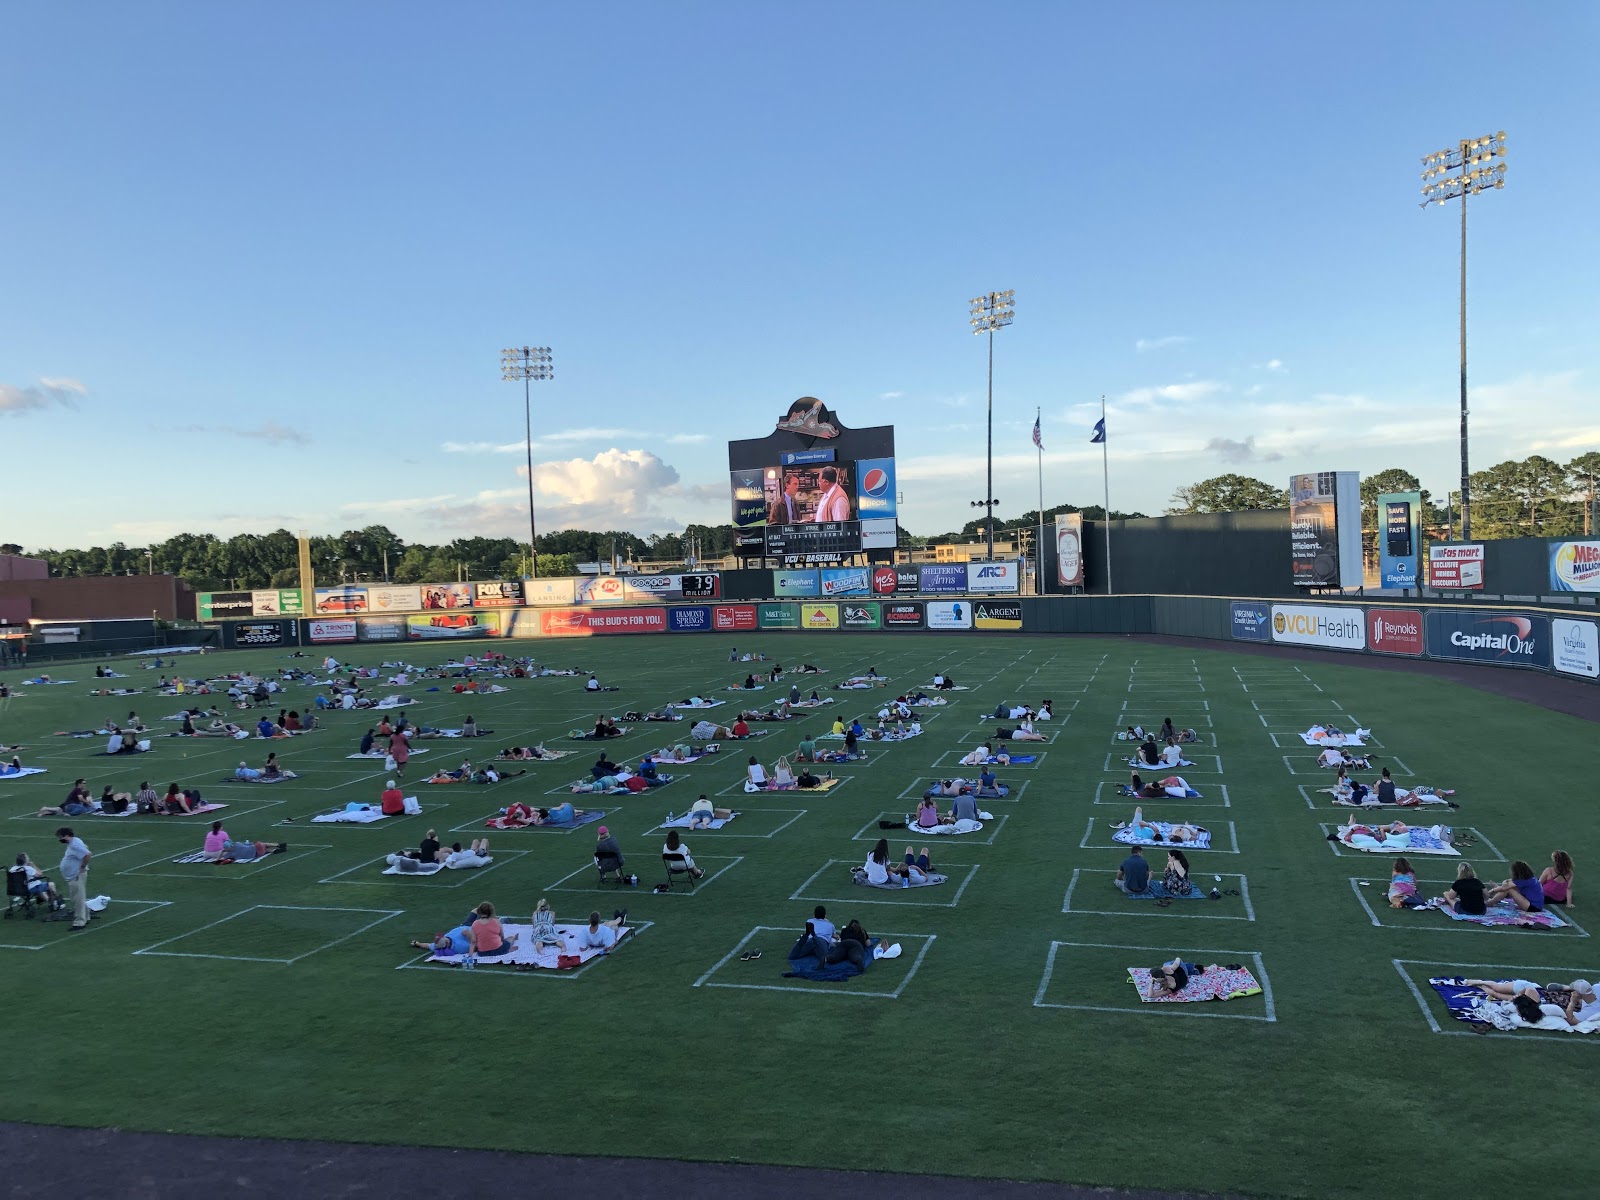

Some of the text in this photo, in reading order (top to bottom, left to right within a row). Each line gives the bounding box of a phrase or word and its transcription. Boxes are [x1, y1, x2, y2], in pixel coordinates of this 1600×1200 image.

[867, 499, 888, 507] pepsi
[1291, 522, 1312, 531] Sturdy.
[1292, 542, 1321, 550] Efficient.
[1443, 548, 1480, 558] Fas mart
[1573, 544, 1600, 563] MEG
[785, 554, 842, 563] VCU BASEBALL
[921, 566, 965, 575] SHELTERING
[976, 566, 1007, 578] ARC3
[695, 576, 714, 590] 79
[788, 579, 814, 587] Elephant
[824, 575, 862, 591] WOODFIN
[875, 573, 895, 592] yes.
[928, 574, 956, 587] Arms
[1387, 575, 1416, 584] Elephant
[478, 583, 503, 595] FOX
[201, 601, 253, 609] enterprise
[675, 610, 705, 618] DIAMOND
[989, 608, 1018, 616] ARGENT
[1234, 609, 1255, 618] VIRGINIA
[588, 615, 663, 626] THIS BUD'S FOR YOU.
[677, 617, 704, 625] SPRINGS
[1286, 614, 1359, 639] VCU Health
[1385, 622, 1418, 636] Reynolds
[1450, 631, 1535, 655] Capital One
[1563, 636, 1586, 648] Virginia
